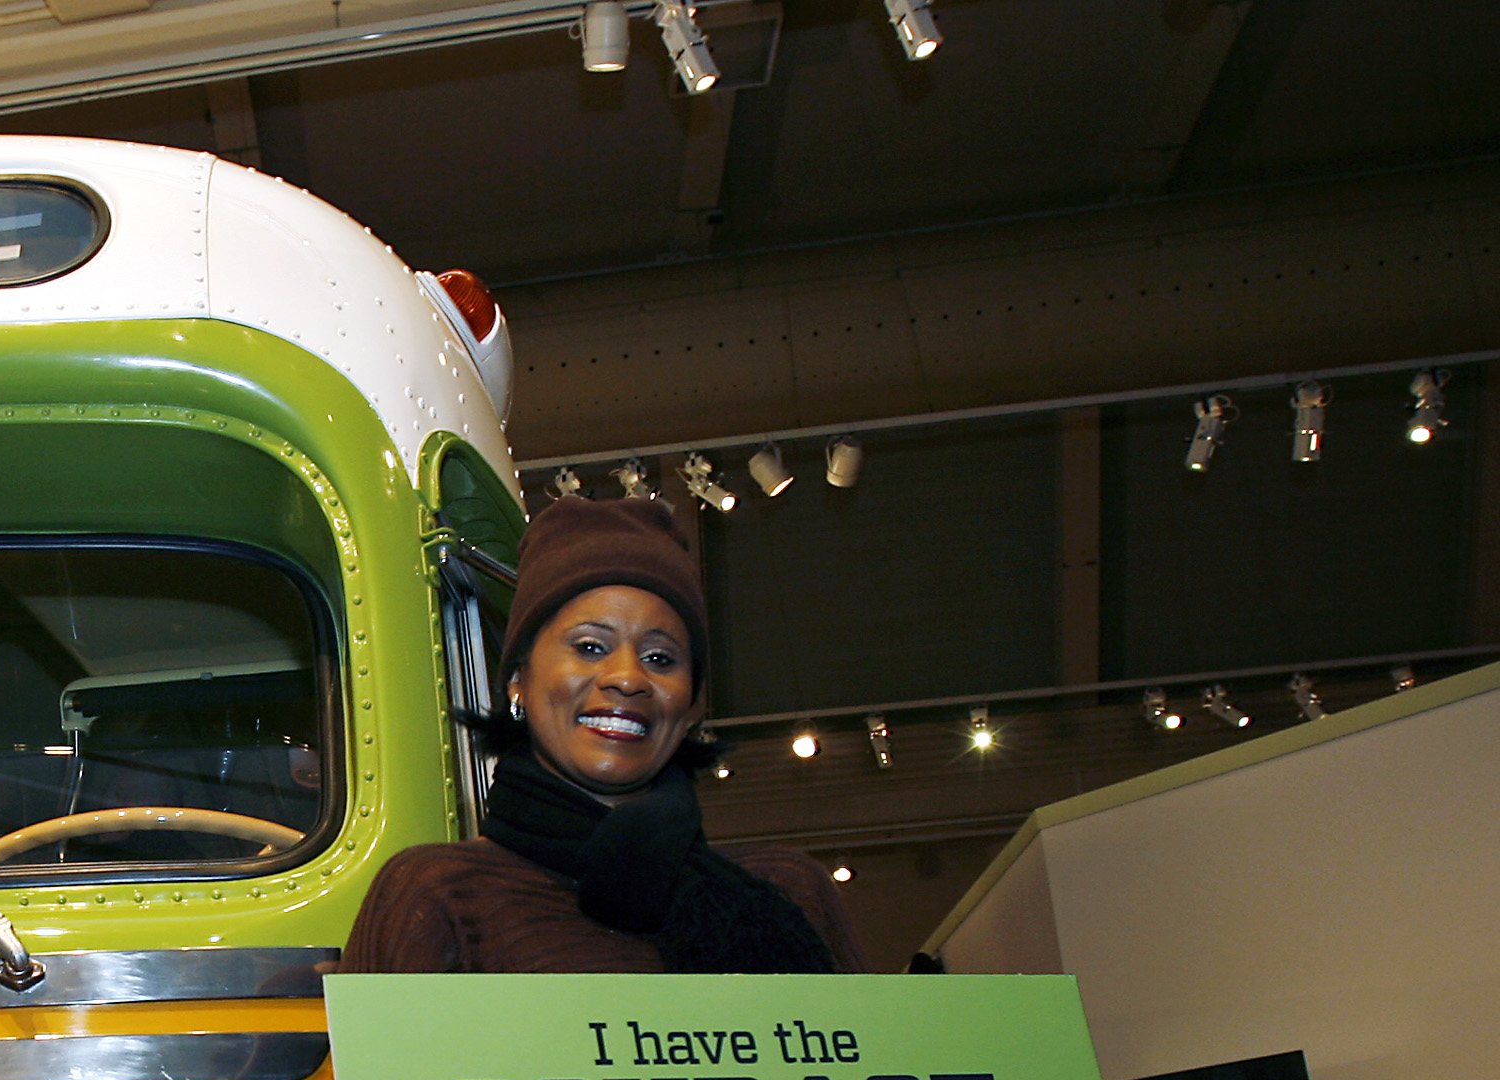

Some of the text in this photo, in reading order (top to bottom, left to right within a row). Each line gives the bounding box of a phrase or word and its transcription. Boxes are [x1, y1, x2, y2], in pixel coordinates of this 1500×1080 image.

[588, 1020, 861, 1067] I have the
